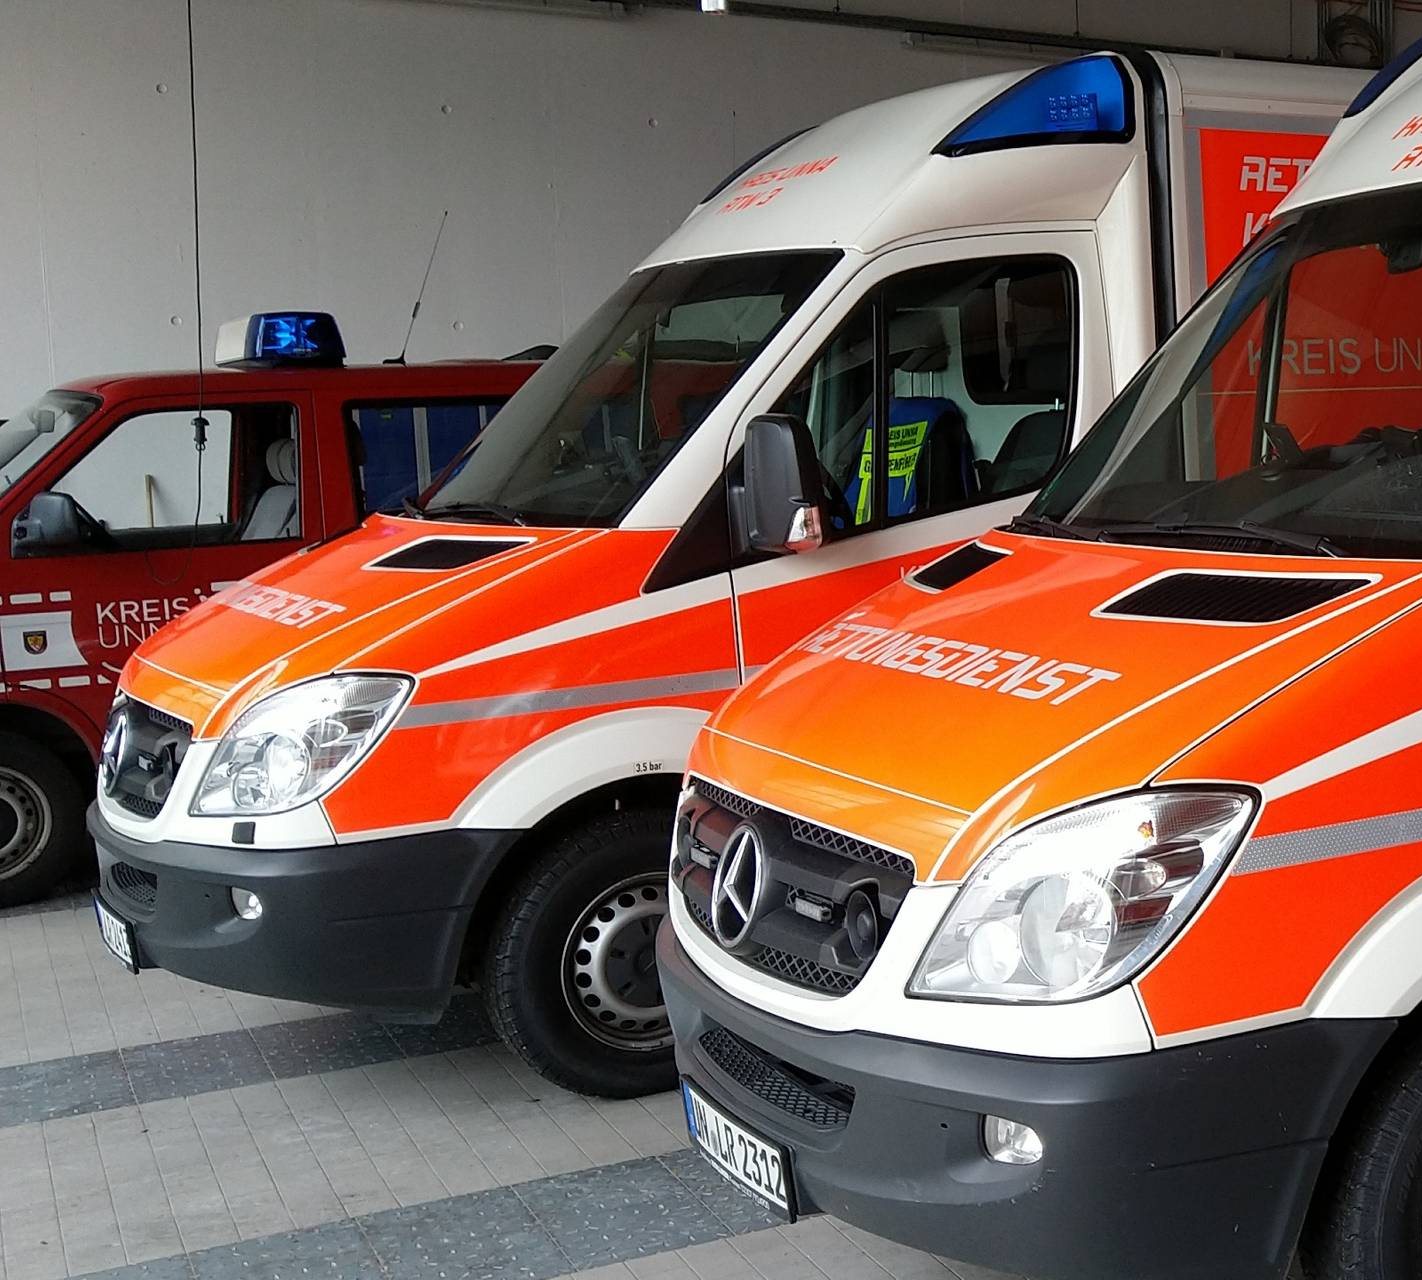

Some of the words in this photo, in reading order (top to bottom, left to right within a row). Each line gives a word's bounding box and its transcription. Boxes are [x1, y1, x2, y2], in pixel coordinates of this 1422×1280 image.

[1240, 156, 1314, 192] RET
[1247, 337, 1361, 376] KREIS
[96, 597, 190, 625] KREIS
[797, 622, 1123, 706] RETTUNGSDIENST
[649, 761, 662, 771] bar
[715, 1115, 739, 1171] LR
[738, 1134, 787, 1201] 2312
